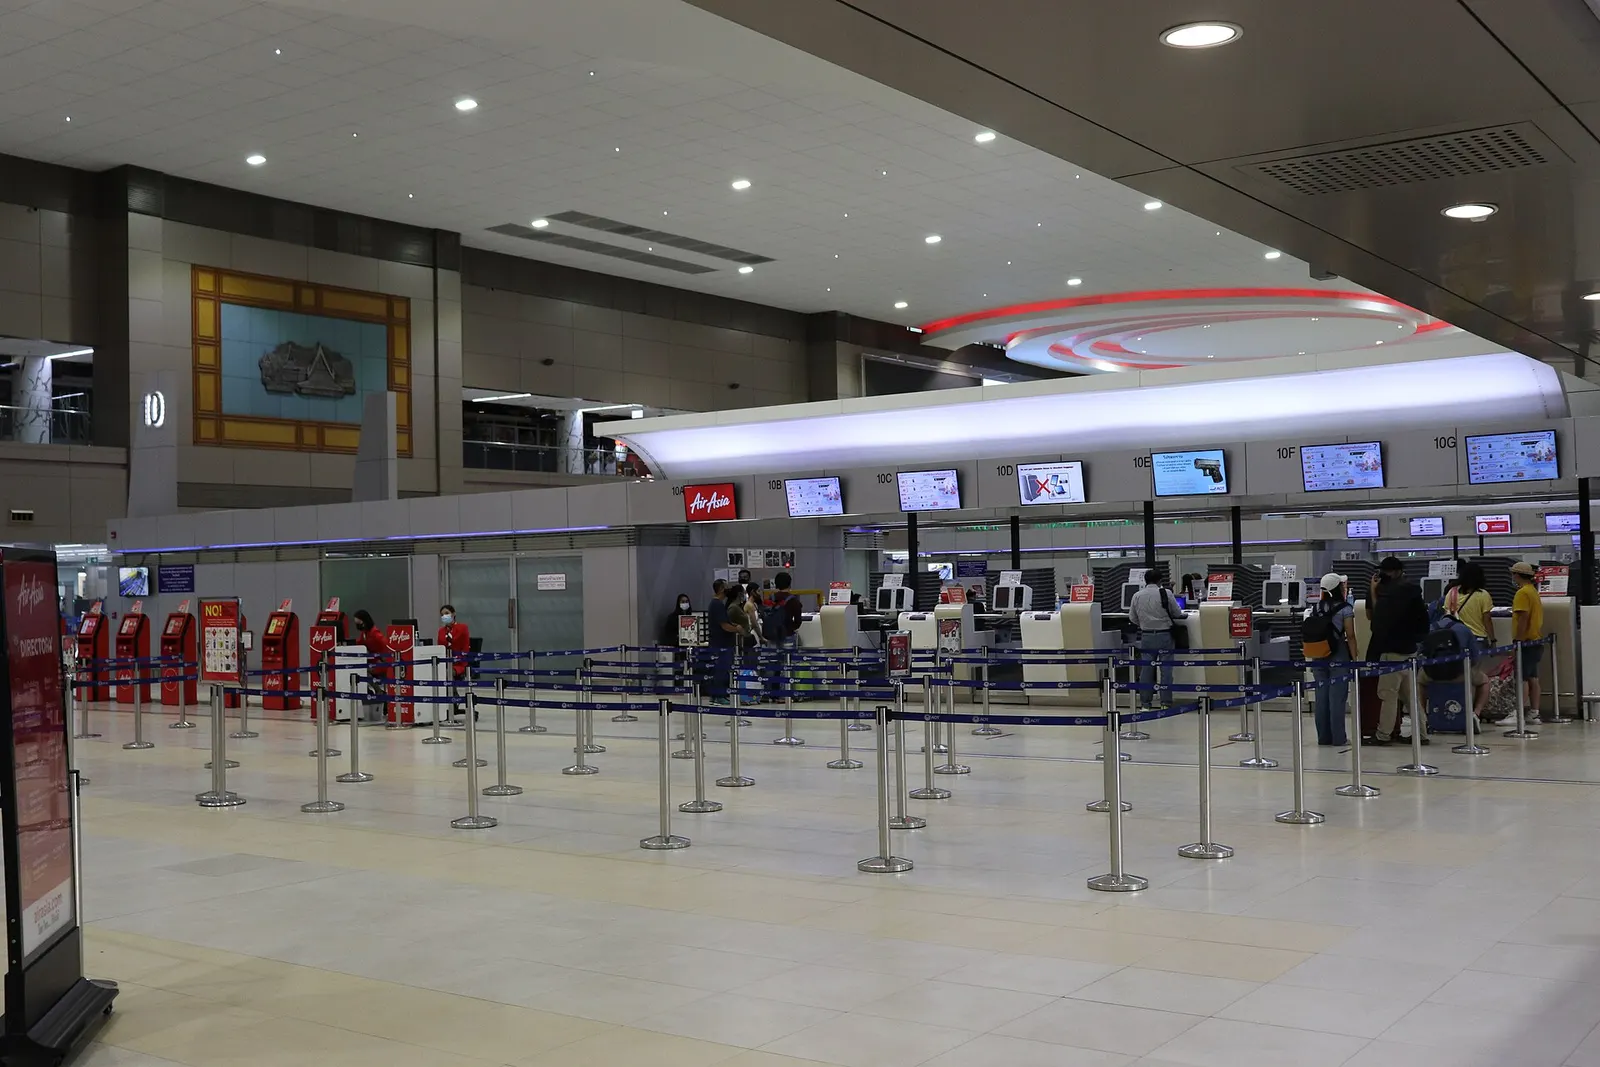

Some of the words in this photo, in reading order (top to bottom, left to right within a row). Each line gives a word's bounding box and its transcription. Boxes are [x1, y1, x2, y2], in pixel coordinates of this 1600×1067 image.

[1434, 436, 1456, 449] 10G
[1277, 447, 1296, 459] 10F
[1133, 457, 1151, 468] 10E
[996, 465, 1014, 476] 10D
[877, 473, 893, 484] 10C
[768, 480, 782, 490] 10B
[672, 486, 684, 496] 10A
[205, 605, 222, 617] NO!
